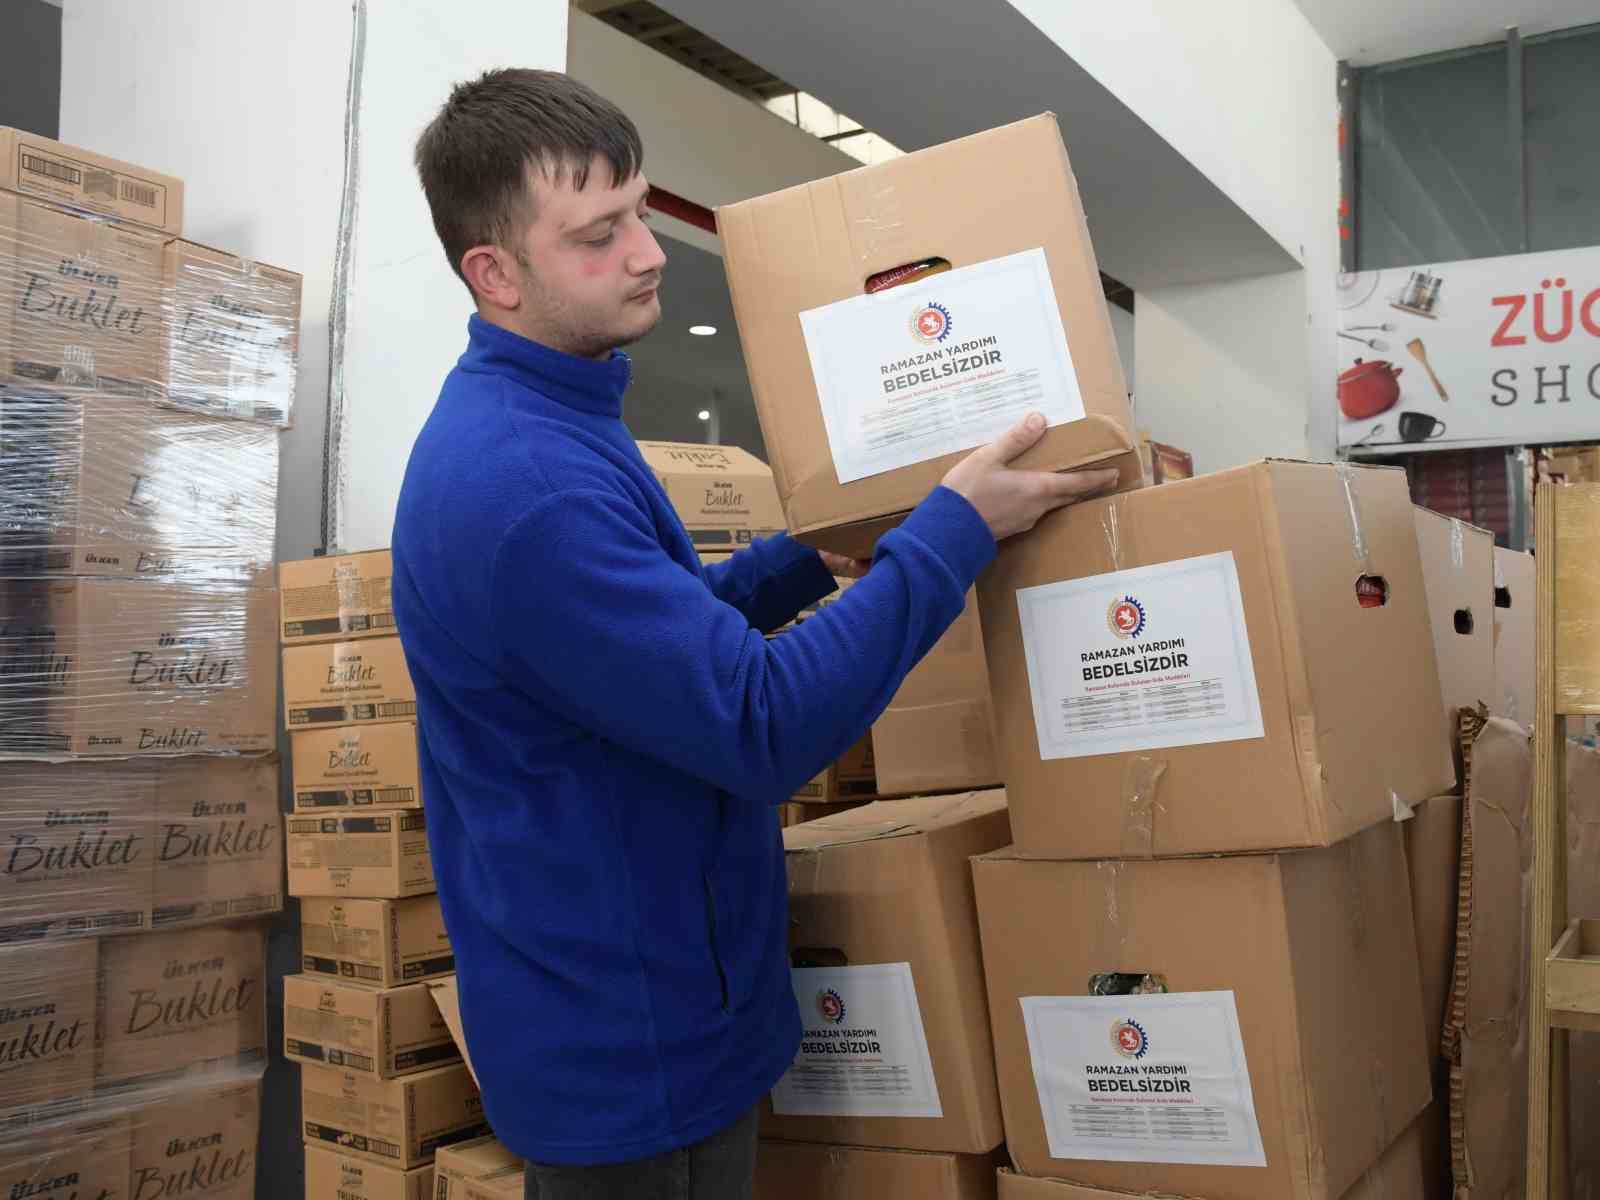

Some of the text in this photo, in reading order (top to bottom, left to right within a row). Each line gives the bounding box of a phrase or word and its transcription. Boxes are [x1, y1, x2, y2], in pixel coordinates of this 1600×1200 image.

[880, 335, 998, 375] RAMAZAN YARDIMI
[882, 349, 1002, 393] BEDELSİZDİR
[1081, 638, 1185, 662] RAMAZAN YARDIMI
[1082, 652, 1189, 681] BEDELSİZDİR
[128, 651, 233, 684] Buklet
[138, 728, 209, 749] Buklet
[3, 830, 144, 874] Buklet
[160, 820, 275, 862] Buklet
[127, 977, 255, 1034] Buklet
[0, 1019, 89, 1064] uklet
[800, 1040, 881, 1054] BEDELSİZDİR
[803, 1029, 877, 1038] AMAZAN YARDIMI
[1086, 1065, 1187, 1075] RAMAZAN YARDIMI
[1087, 1076, 1191, 1092] BEDELSİZDİR
[135, 1149, 250, 1200] Buklet
